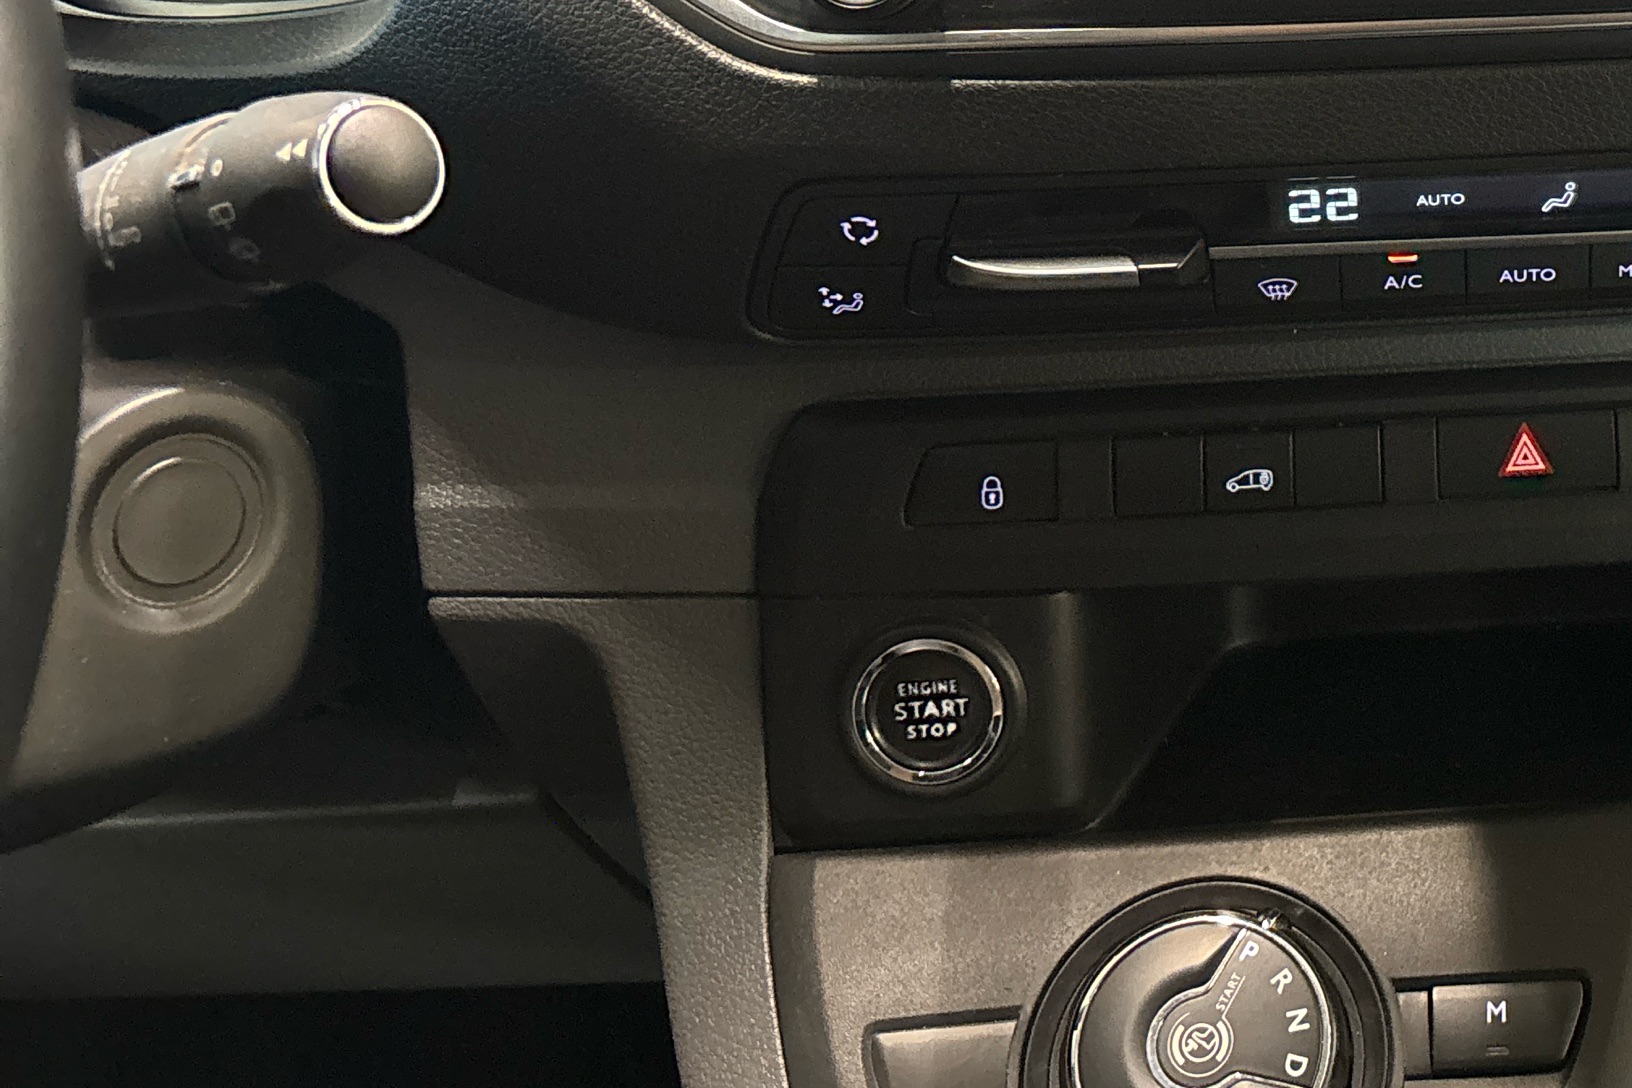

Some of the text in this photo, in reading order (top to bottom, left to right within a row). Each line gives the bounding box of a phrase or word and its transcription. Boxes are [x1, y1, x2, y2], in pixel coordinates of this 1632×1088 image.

[1288, 187, 1466, 224] 22 AUTO
[1384, 274, 1423, 290] A/C
[1499, 268, 1557, 283] AUTO
[897, 679, 960, 698] ENGINE
[894, 698, 969, 721] START
[907, 722, 957, 739] STOP
[1214, 970, 1243, 1013] START
[1237, 939, 1311, 1078] P R N D
[1486, 1000, 1507, 1024] M
